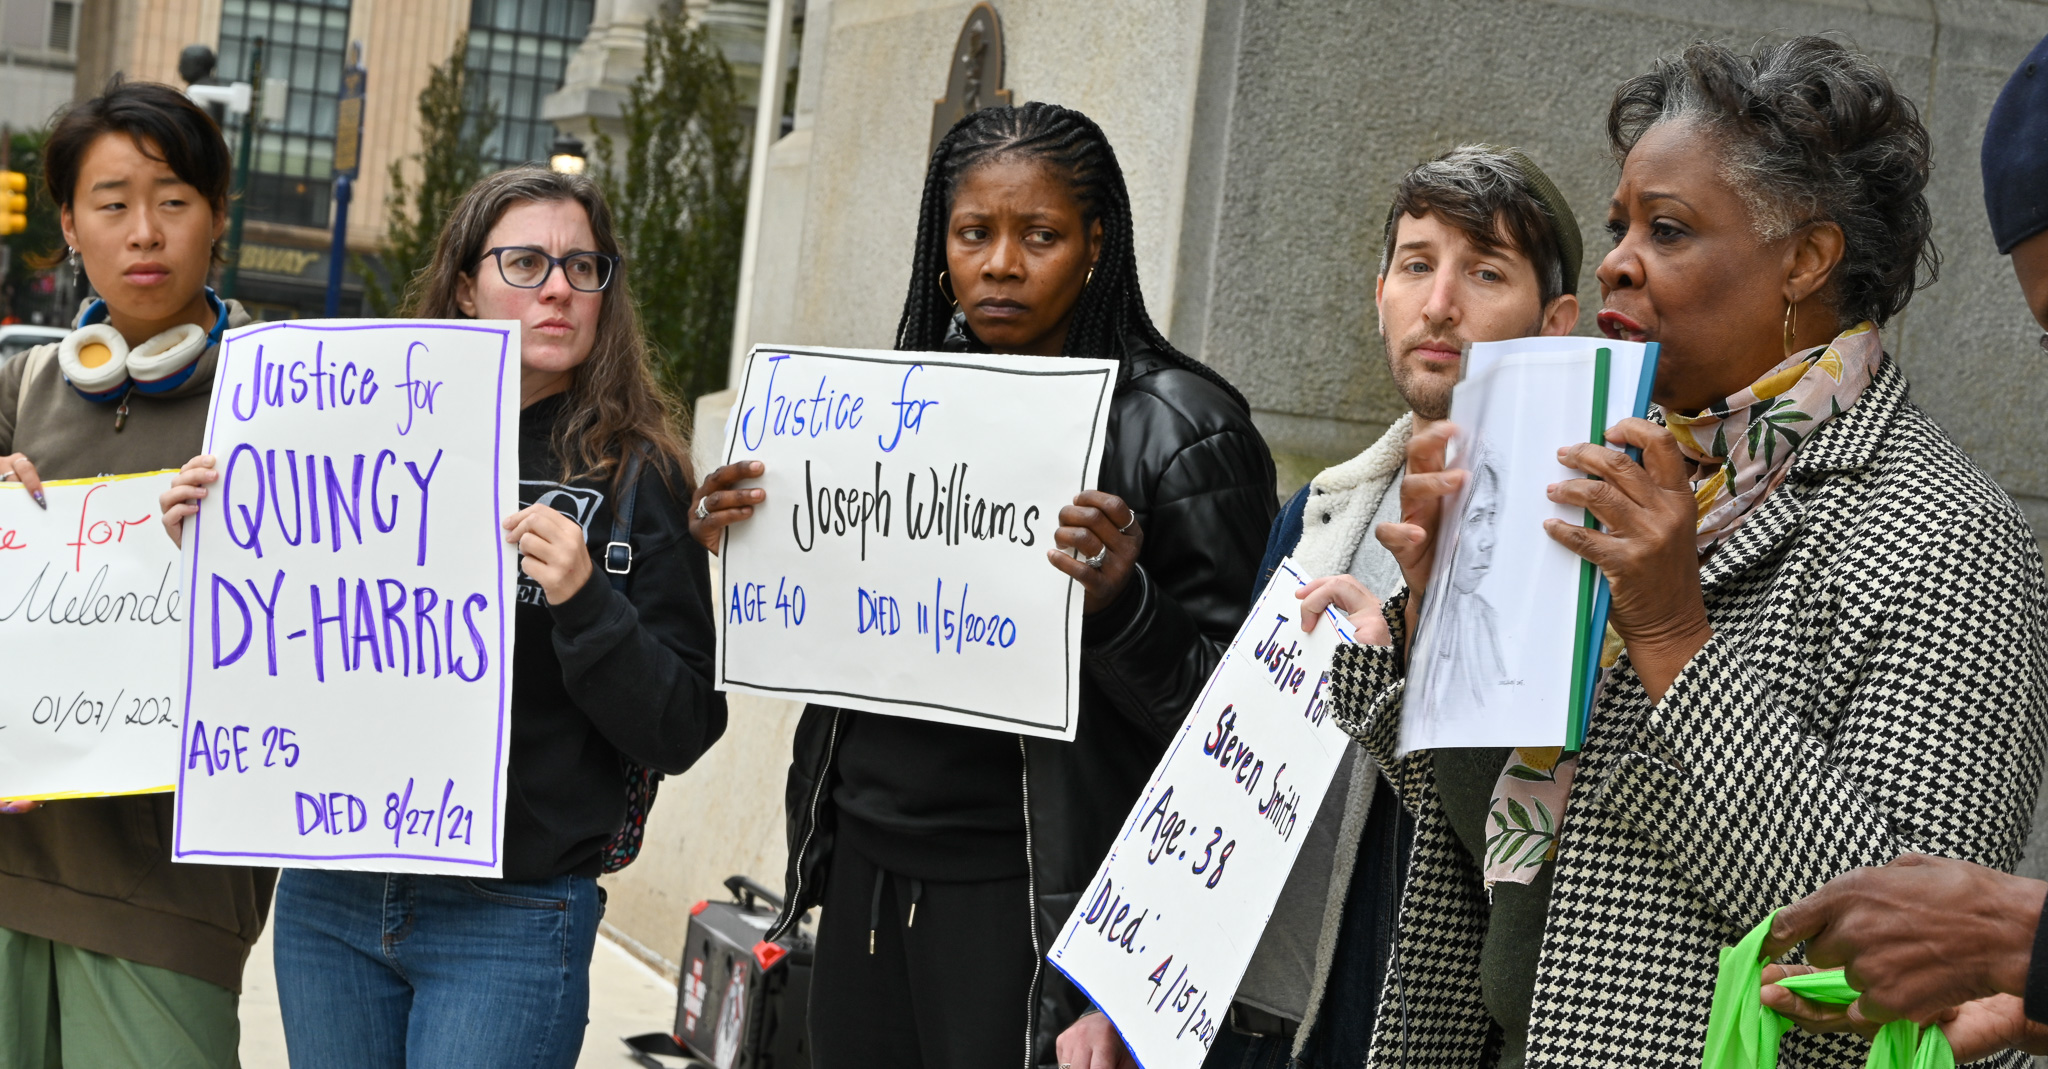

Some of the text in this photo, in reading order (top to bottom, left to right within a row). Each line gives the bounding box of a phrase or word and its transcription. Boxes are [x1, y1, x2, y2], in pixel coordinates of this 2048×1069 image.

[221, 243, 319, 275] BWAY
[231, 340, 444, 436] Justice for
[742, 354, 940, 453] Justice for
[66, 484, 152, 572] for
[222, 442, 444, 567] QUINCY
[792, 459, 1040, 562] Joseph Williams
[0, 560, 182, 626] Melende
[210, 569, 489, 683] DY-HARRIS
[729, 581, 767, 625] AGE
[774, 575, 806, 629] 40
[917, 577, 1017, 655] 11/5/2020
[1254, 613, 1306, 695] Justice
[32, 688, 179, 733] 01/07/202
[187, 719, 300, 777] AGE 25
[294, 777, 474, 848] DIED 8/27/21
[1203, 703, 1301, 843] Steven Smith
[1140, 785, 1237, 890] Age: 38
[1084, 877, 1215, 1053] Died: 4/15/202
